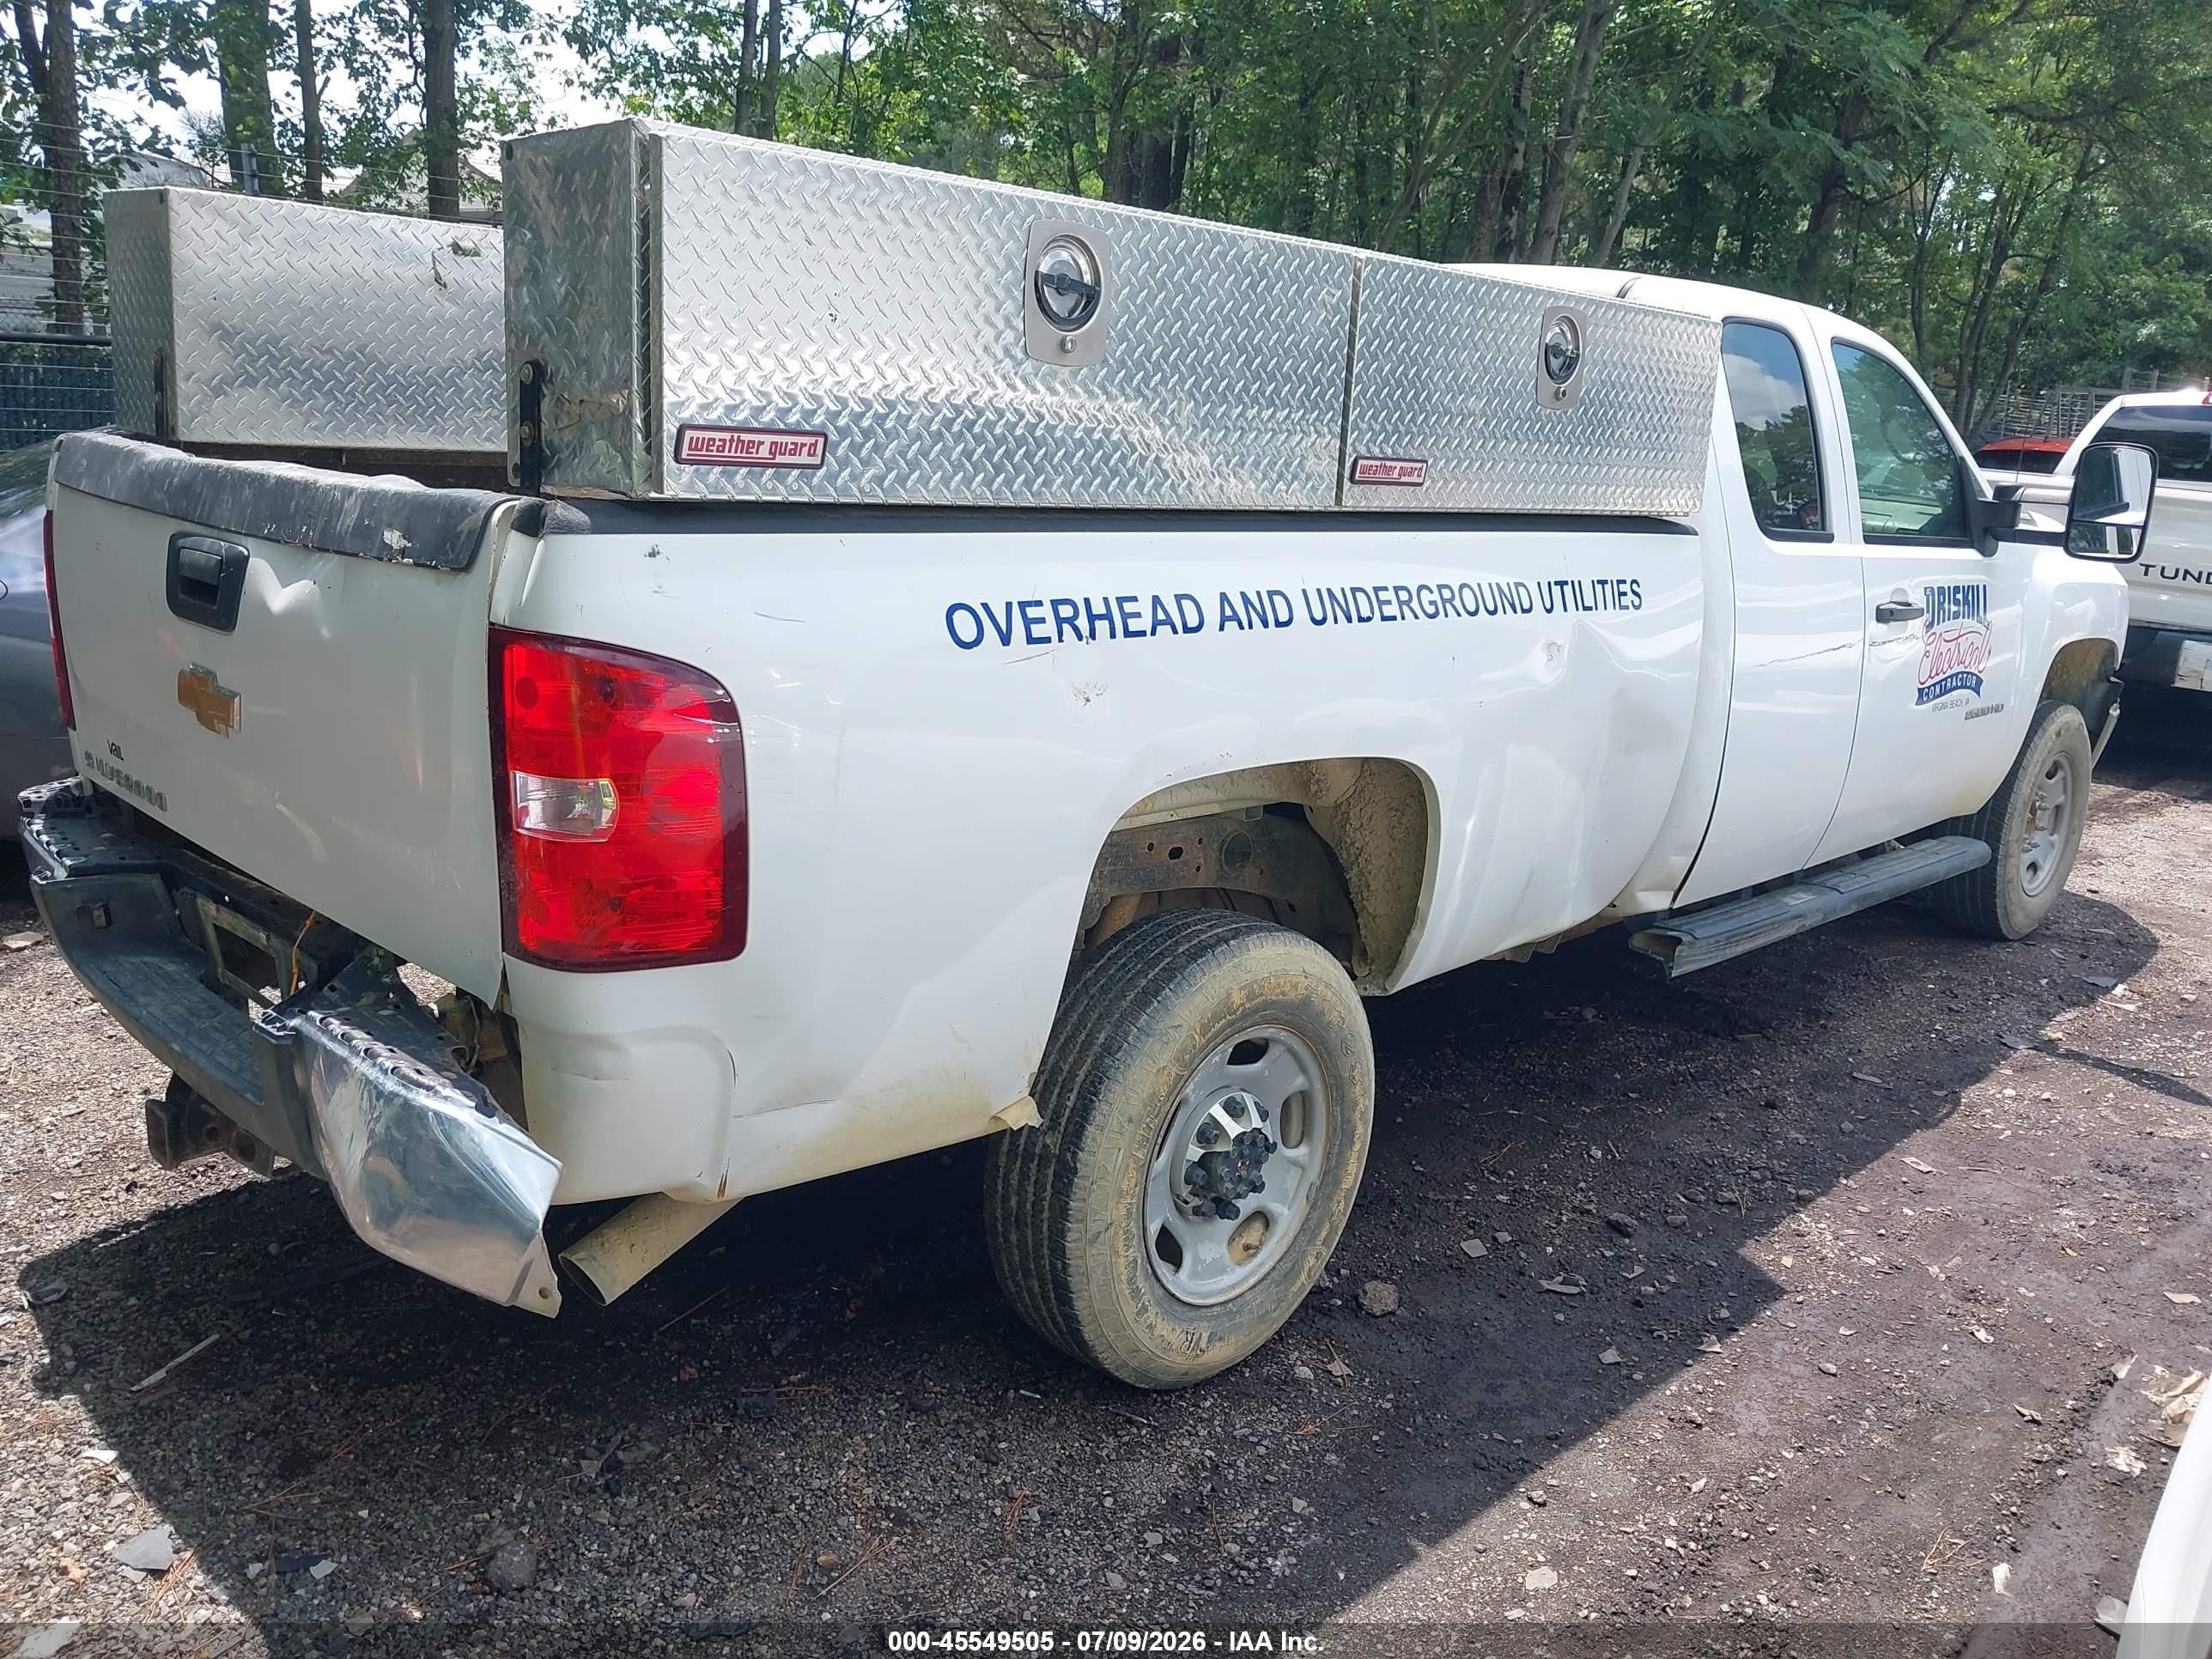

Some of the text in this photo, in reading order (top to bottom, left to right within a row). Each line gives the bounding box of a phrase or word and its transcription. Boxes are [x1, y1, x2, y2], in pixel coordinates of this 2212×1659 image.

[687, 434, 818, 459] weather guard
[1358, 462, 1424, 479] weather guard
[945, 578, 1644, 651] OVERHEAD AND UNDERGROUND UTILITIES
[1923, 584, 1990, 632] DRISKILL
[1917, 622, 1992, 685] Electrical
[1923, 674, 1977, 702] CONTRACTOR
